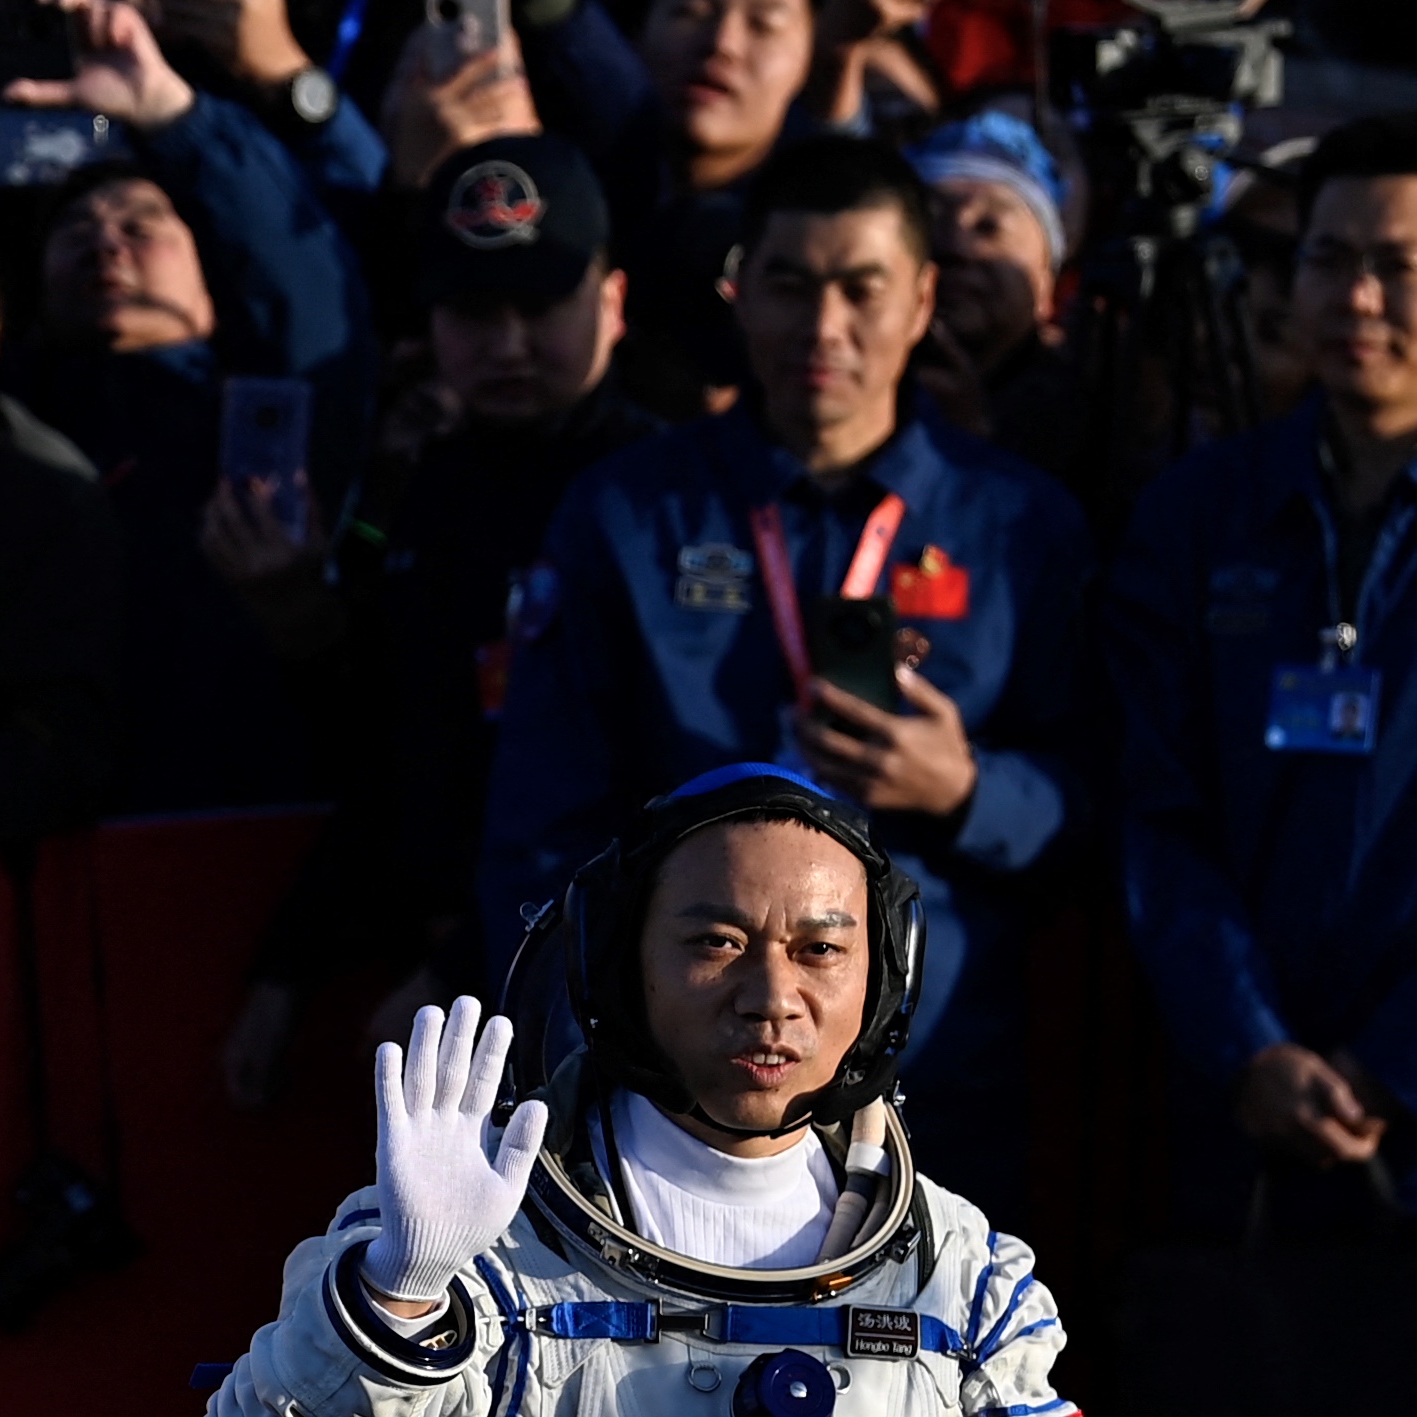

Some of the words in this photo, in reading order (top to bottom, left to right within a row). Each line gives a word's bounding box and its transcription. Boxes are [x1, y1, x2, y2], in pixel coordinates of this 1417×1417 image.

[858, 1313, 912, 1331] 汤洪波
[855, 1339, 890, 1353] Hongbo
[892, 1341, 913, 1355] Tang
